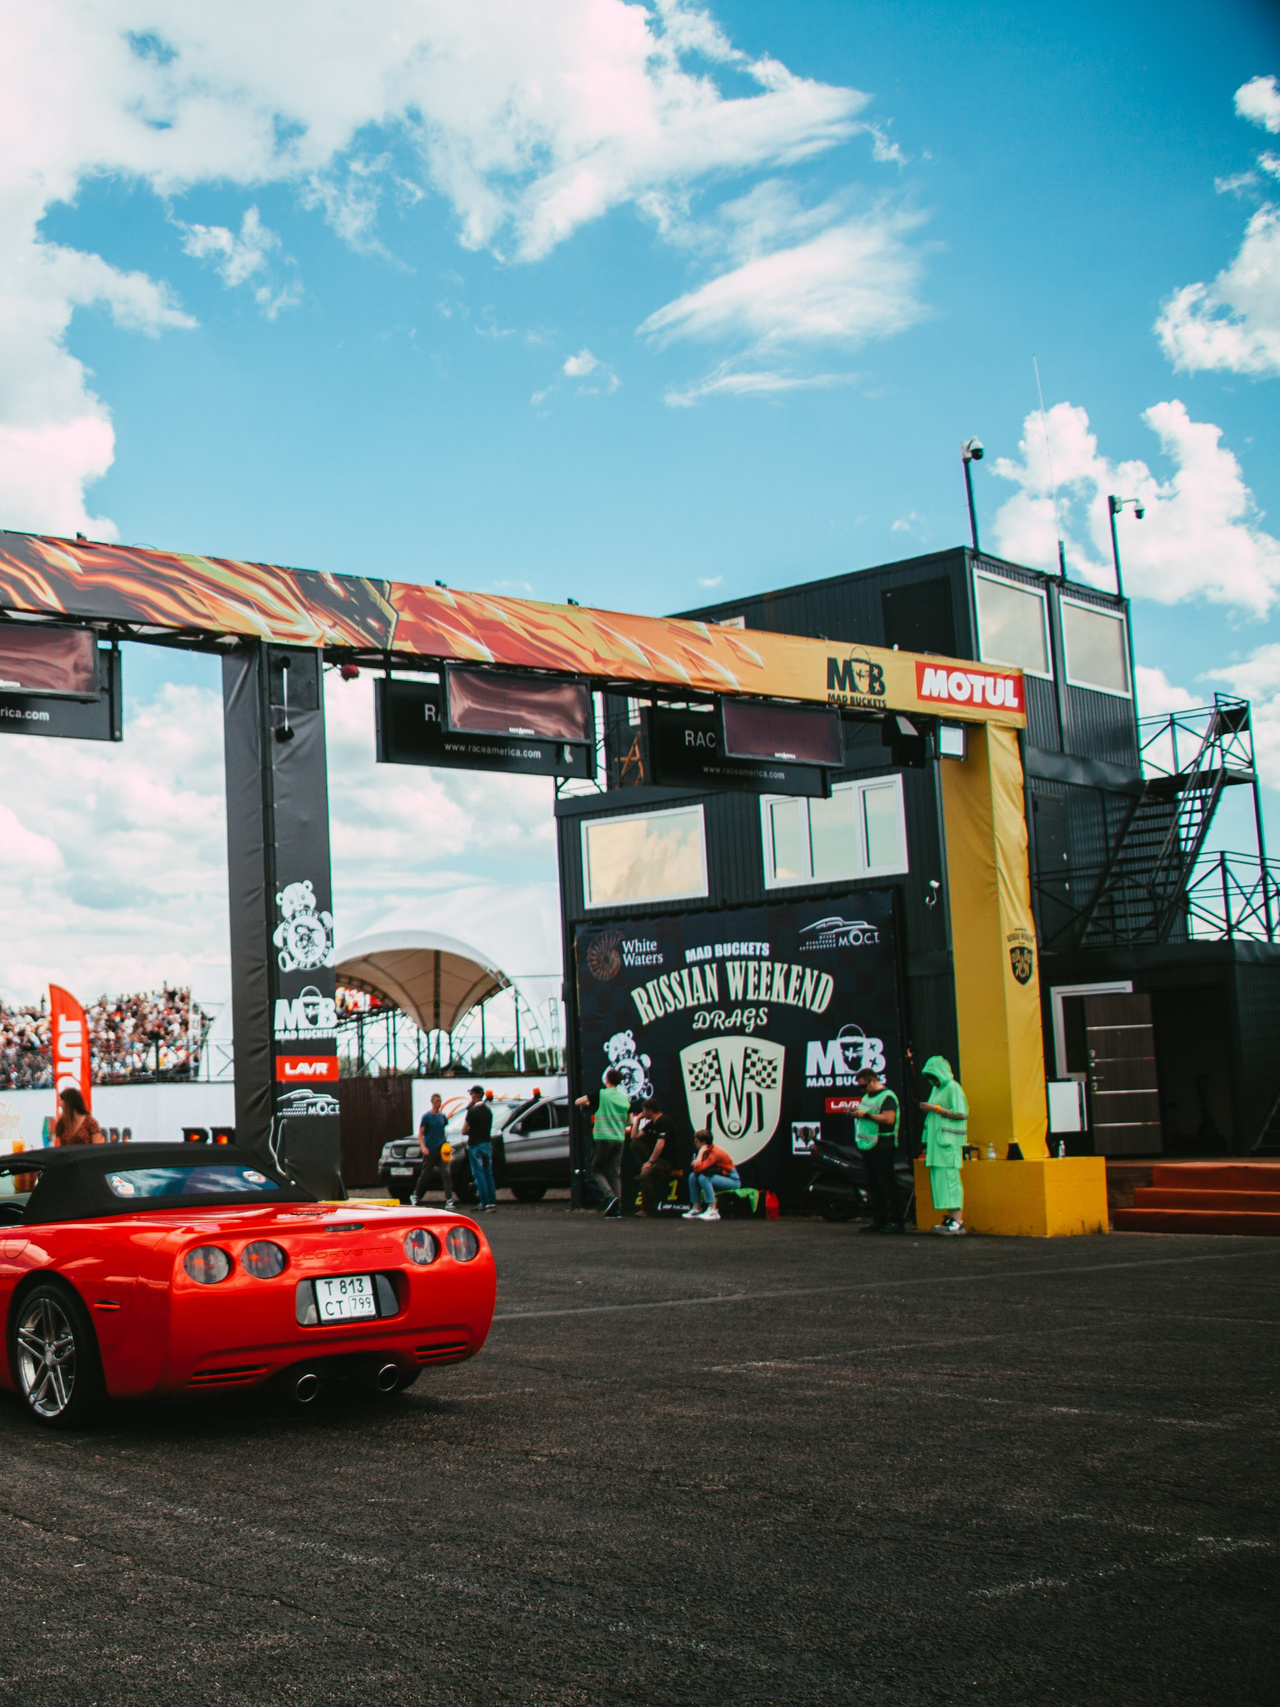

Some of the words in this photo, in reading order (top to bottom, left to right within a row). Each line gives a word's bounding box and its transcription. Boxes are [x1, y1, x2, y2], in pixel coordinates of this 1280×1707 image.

[920, 667, 1020, 708] MOTUL
[827, 692, 849, 704] MAD
[849, 695, 888, 709] BUCKETS
[443, 741, 542, 759] www.raceamerica.com
[702, 763, 786, 781] www.raceamerica.com
[622, 938, 659, 953] White
[685, 944, 714, 963] MAD
[714, 941, 770, 959] BUCKETS
[622, 951, 664, 967] Waters
[630, 962, 720, 1026] RUSSIAN
[726, 960, 835, 1014] WEEKEND
[692, 1006, 769, 1033] DRAGS
[274, 1029, 298, 1041] MAD
[298, 1028, 338, 1041] BUCKETS
[284, 1062, 330, 1076] LAVR
[806, 1075, 834, 1088] MAD
[323, 1280, 333, 1296] T
[339, 1277, 365, 1296] 813
[325, 1300, 344, 1317] CT
[351, 1296, 372, 1311] 799
